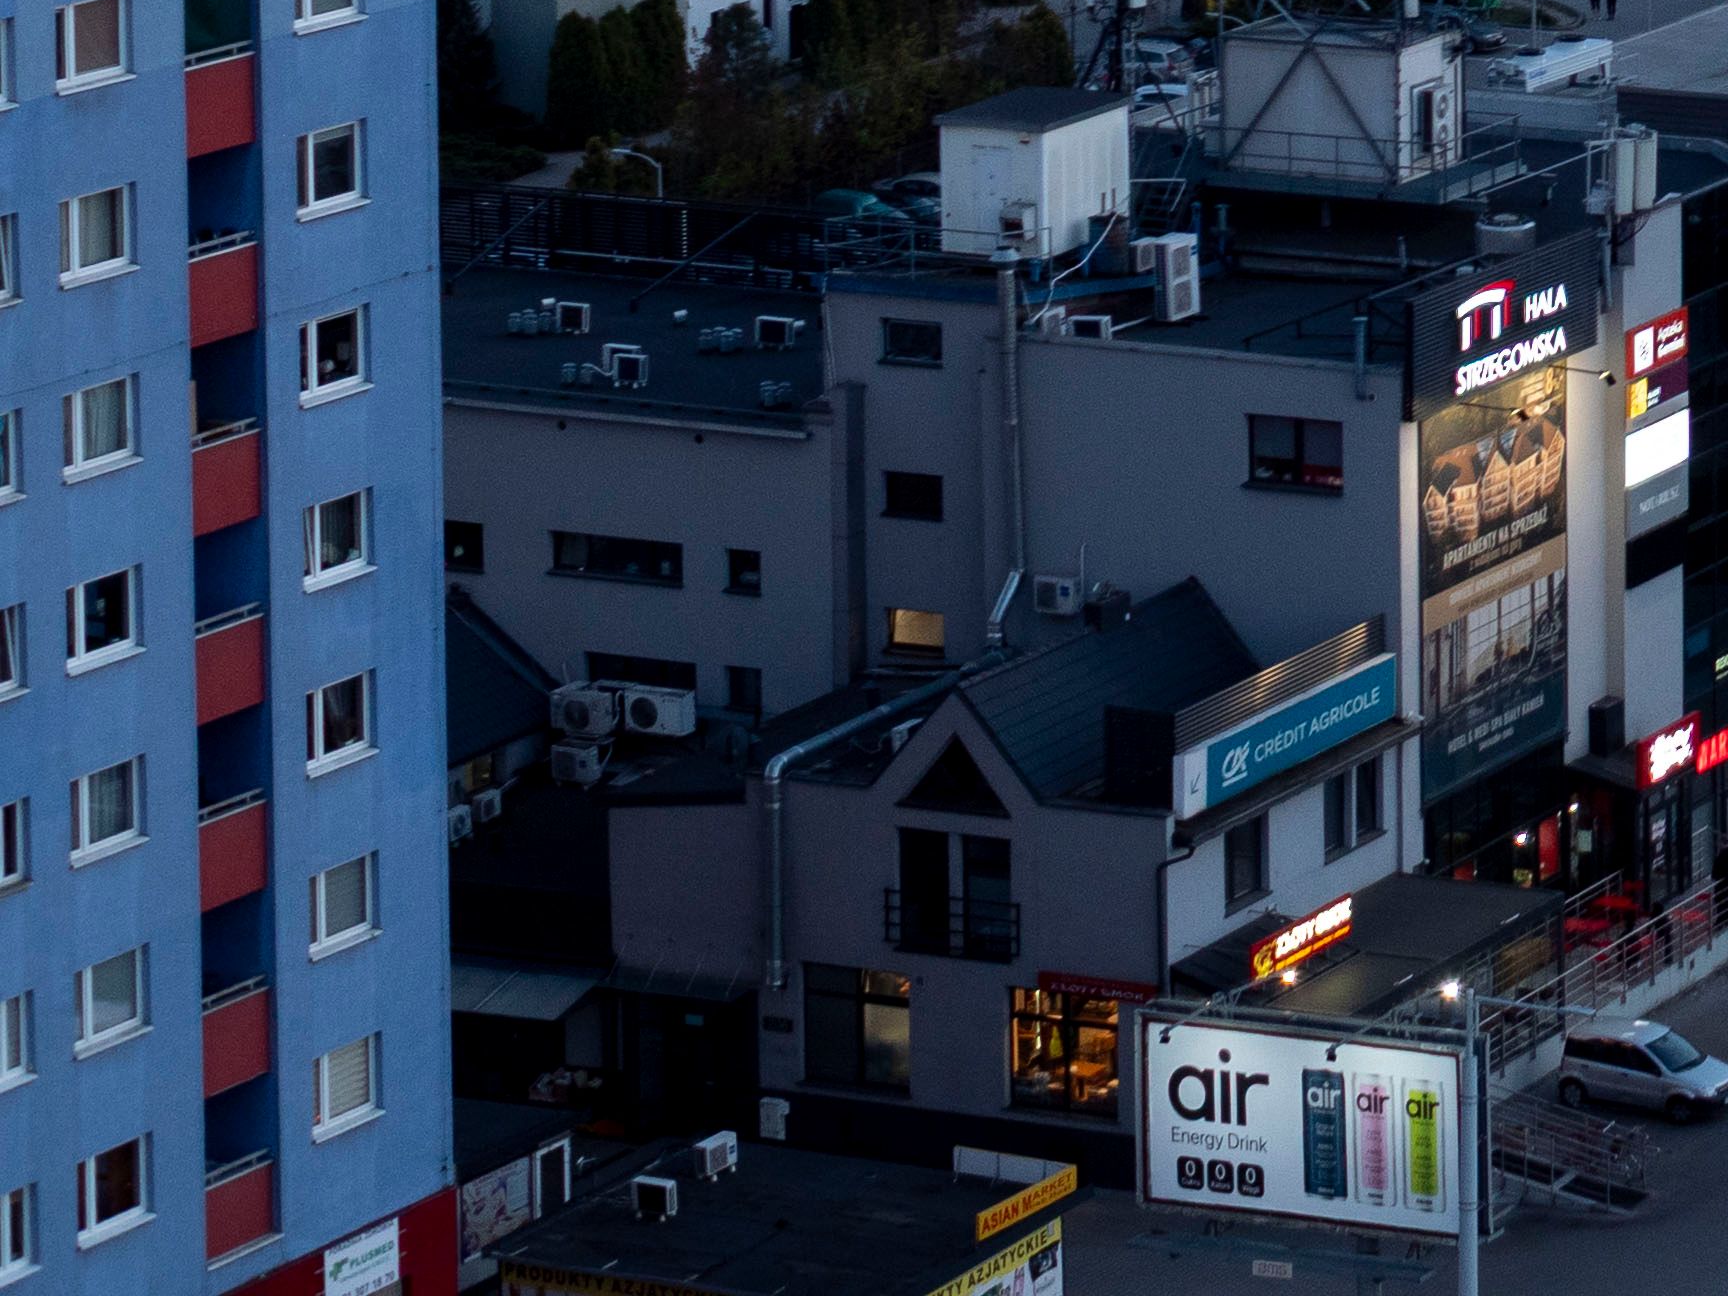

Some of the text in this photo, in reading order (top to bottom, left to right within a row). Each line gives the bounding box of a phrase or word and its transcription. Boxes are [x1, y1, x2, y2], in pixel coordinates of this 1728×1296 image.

[1524, 284, 1568, 322] HALA
[1455, 327, 1568, 397] STRZEGOMSKA
[1308, 685, 1382, 736] AGRICOLE
[1168, 1048, 1270, 1126] air
[1307, 1081, 1341, 1109] air
[1356, 1087, 1390, 1114] air
[1405, 1093, 1440, 1120] air
[1171, 1126, 1269, 1153] Energy Drink
[1185, 1160, 1196, 1177] 0
[1215, 1163, 1226, 1180] 0
[1245, 1167, 1256, 1184] 0
[981, 1204, 1019, 1235] ASIAN
[1022, 1171, 1073, 1214] MARKET
[349, 1240, 394, 1269] PLUSMED
[968, 1228, 1048, 1288] AZJATYCKIE
[504, 1262, 606, 1291] PRODUKTY
